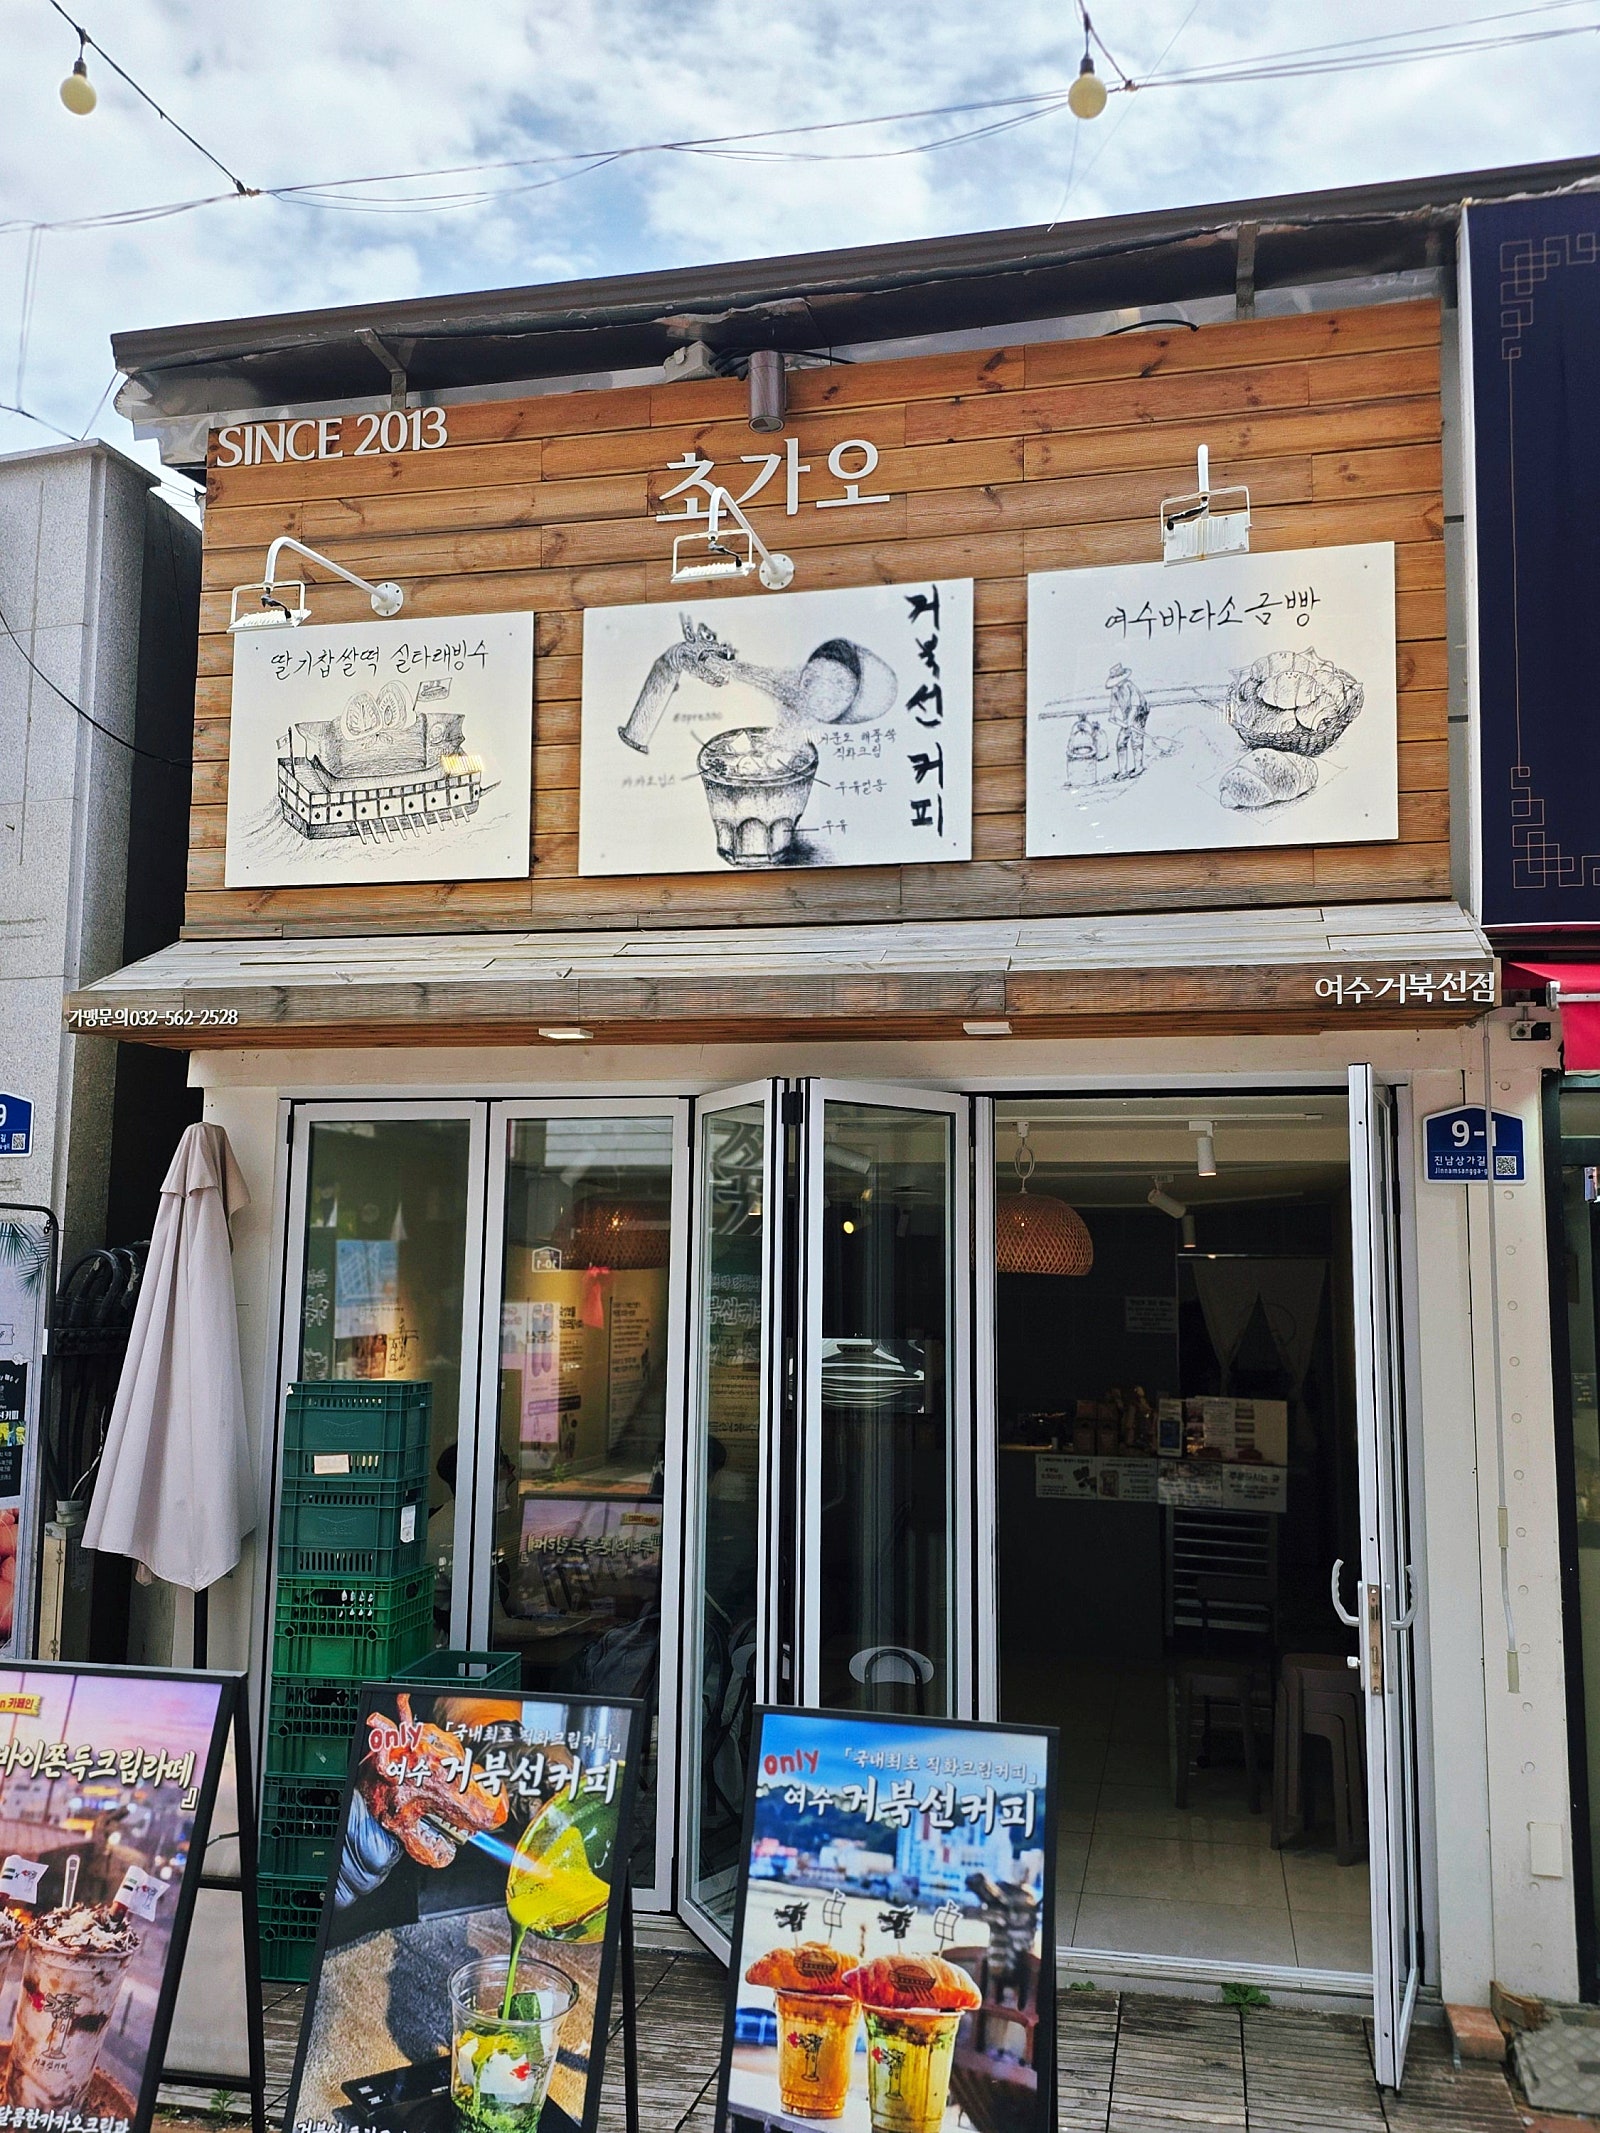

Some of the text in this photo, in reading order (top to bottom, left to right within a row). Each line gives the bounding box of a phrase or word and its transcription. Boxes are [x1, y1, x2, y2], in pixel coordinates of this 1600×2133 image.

[216, 406, 449, 467] SINCE 2013
[656, 437, 890, 522] 초가오
[270, 639, 489, 681] 딸기찹쌀떡 실타래빙수
[822, 819, 849, 835] 우유
[1434, 1155, 1486, 1167] 진남상가길
[369, 1721, 425, 1752] only
[386, 1748, 619, 1804] 여수 거북선커피
[764, 1749, 820, 1776] only
[784, 1775, 1036, 1838] 여수 거북선커피
